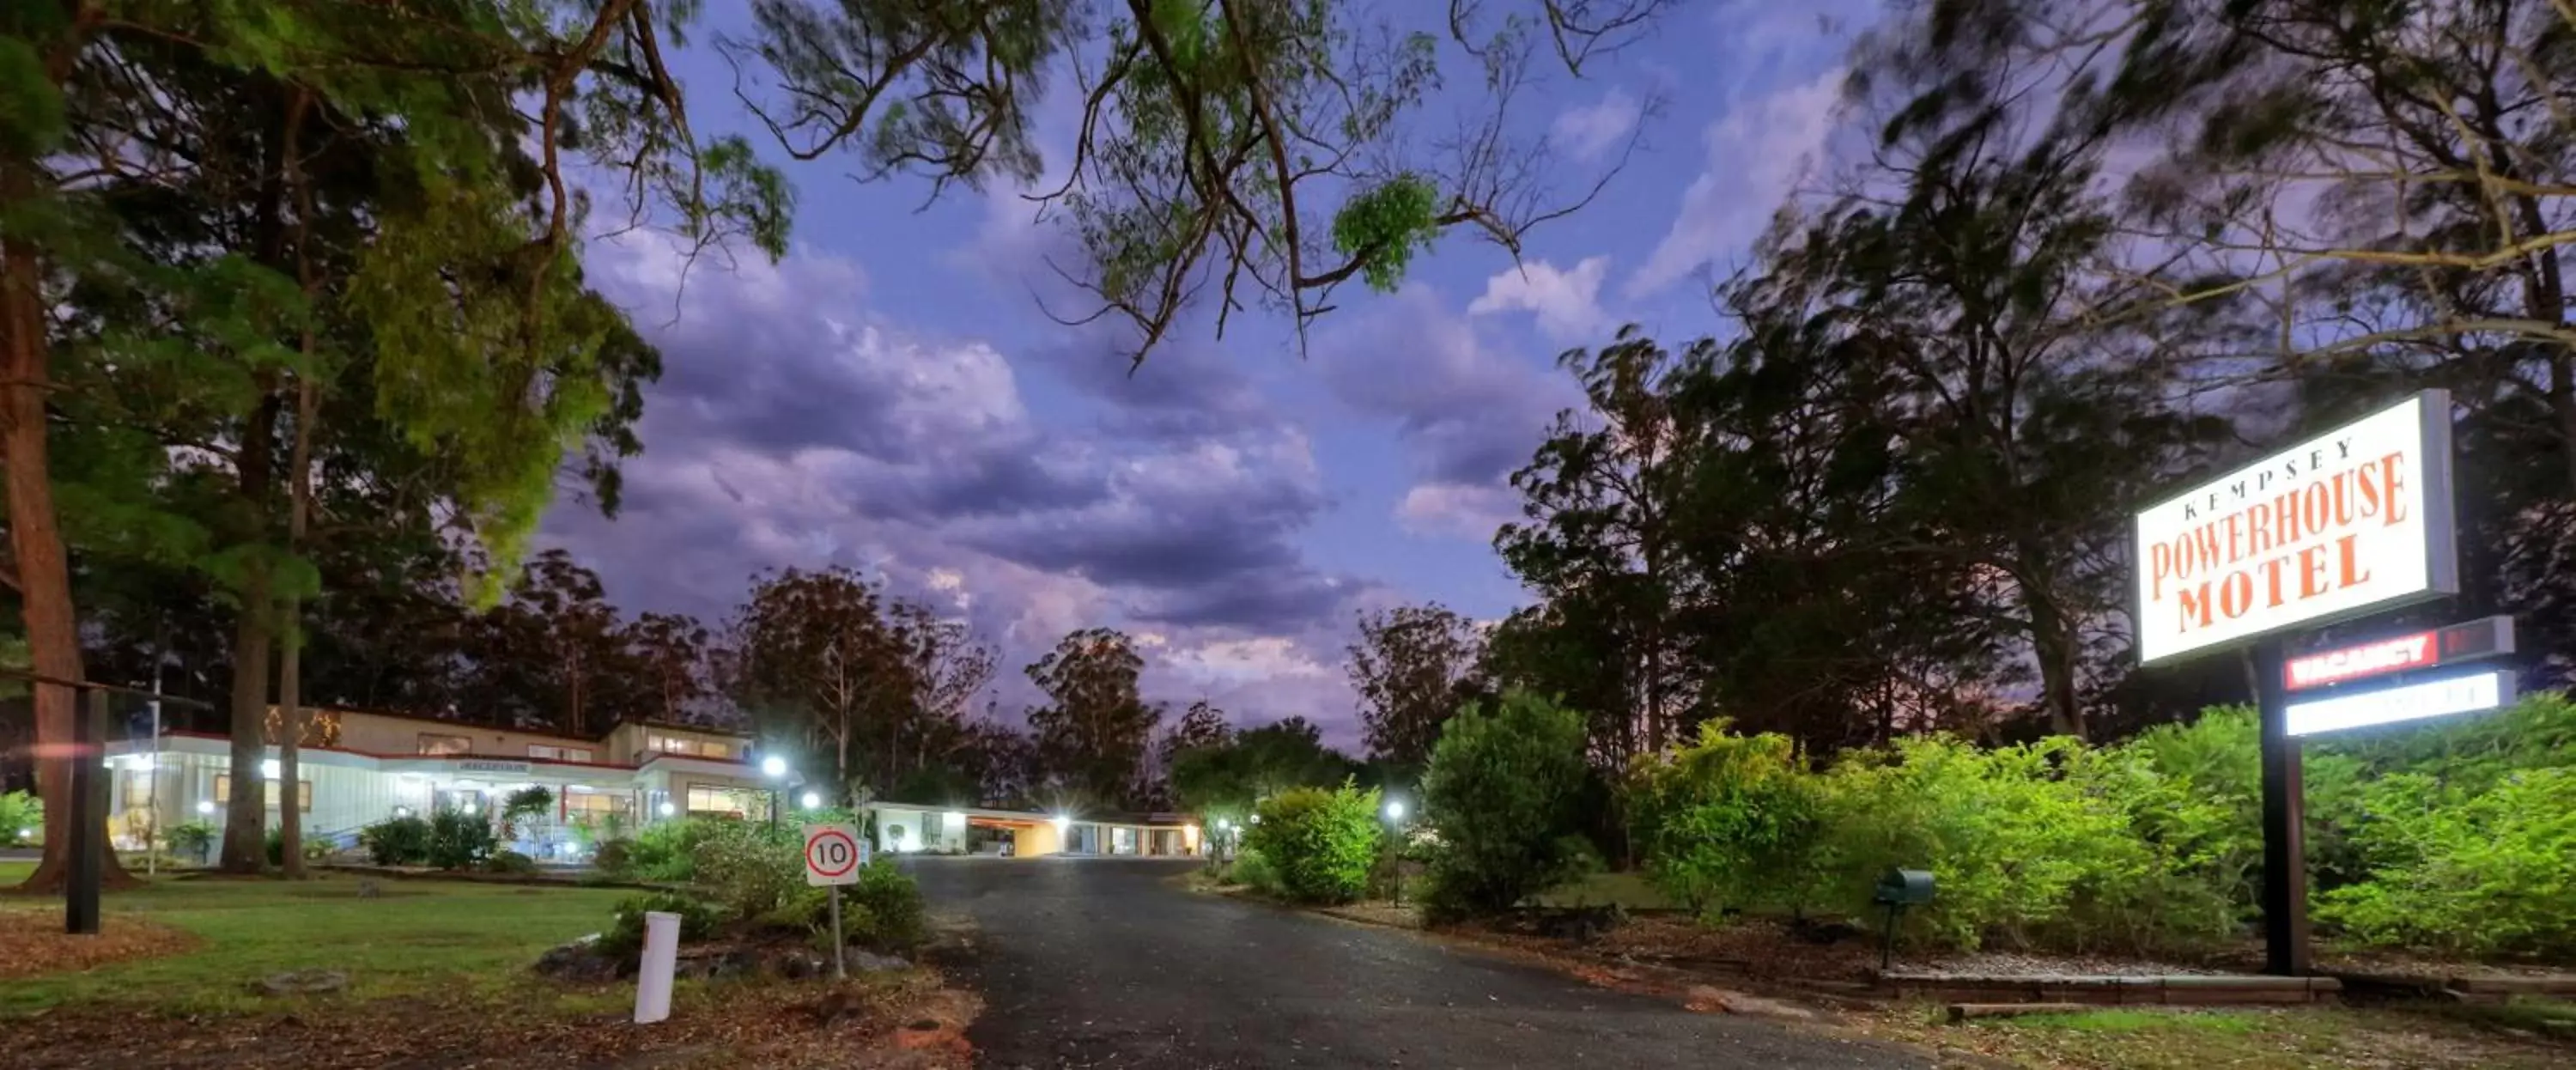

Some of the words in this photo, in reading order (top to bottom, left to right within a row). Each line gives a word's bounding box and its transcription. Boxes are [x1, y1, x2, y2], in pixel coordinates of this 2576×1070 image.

[2185, 438, 2353, 520] KEMPSEY
[2151, 451, 2407, 601] POWERHOUSE
[2178, 534, 2371, 634] MOTEL
[2291, 635, 2427, 685] VACANCY
[817, 842, 847, 865] 10
